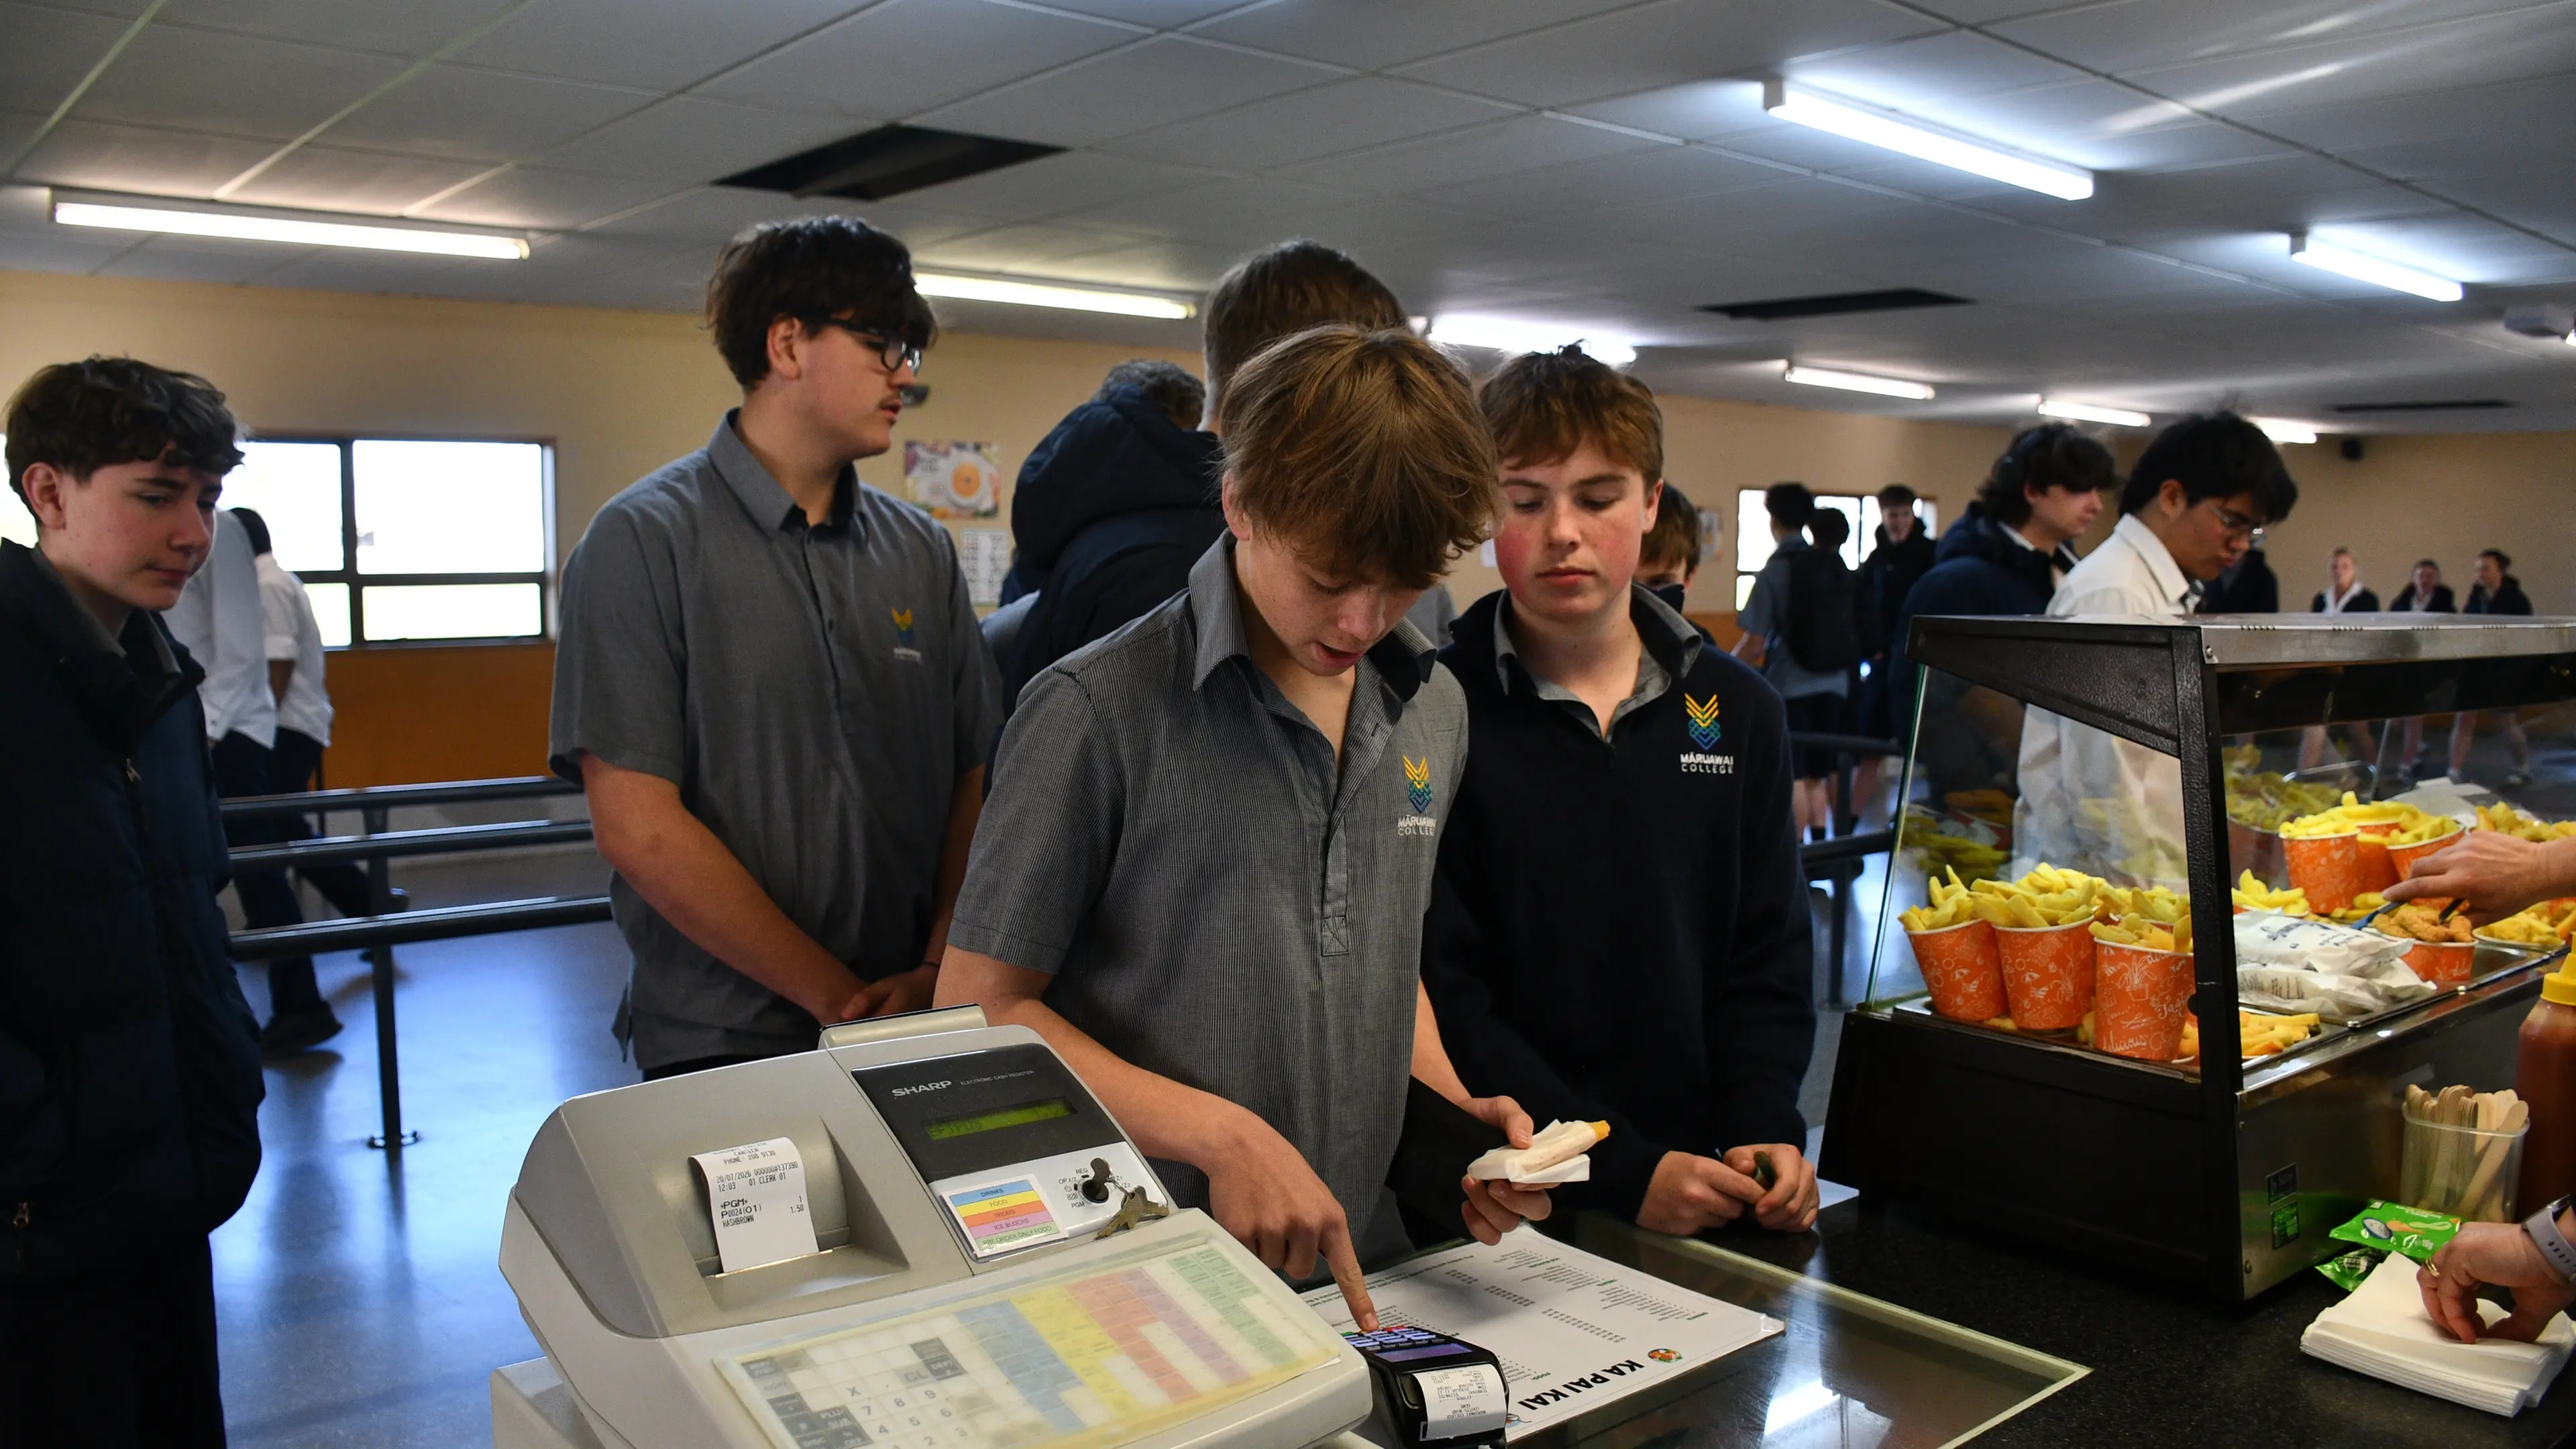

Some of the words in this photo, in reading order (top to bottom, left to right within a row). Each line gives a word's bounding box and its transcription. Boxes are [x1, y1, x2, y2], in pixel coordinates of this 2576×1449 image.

[1680, 752, 1733, 765] MĀRUAWAI
[1681, 763, 1733, 774] COLLEGE
[892, 1080, 952, 1096] SHARP
[960, 1076, 993, 1085] ELECTRONIC
[1008, 1070, 1034, 1078] REGISTER
[718, 1182, 736, 1192] 12:03
[749, 1178, 756, 1186] 01
[759, 1174, 777, 1185] CLERK
[779, 1172, 786, 1181] 01
[981, 1188, 1004, 1197] DRINKS
[790, 1203, 804, 1214] 1.50
[989, 1199, 1008, 1208] FOOD
[994, 1209, 1016, 1218] TREATS
[722, 1214, 755, 1228] HASHBROWN
[1006, 1218, 1029, 1228] BLOCKS
[983, 1237, 994, 1245] PRE
[995, 1232, 1018, 1243] ORDER
[1018, 1230, 1034, 1240] ONLY
[1034, 1226, 1052, 1234] FOOD
[1601, 1359, 1645, 1377] KA
[904, 1371, 928, 1382] CL
[1562, 1373, 1611, 1393] PAI
[846, 1387, 861, 1397] X
[861, 1405, 871, 1415] 7
[894, 1397, 906, 1407] 8
[924, 1389, 936, 1399] 9
[1517, 1388, 1570, 1411] KAI
[879, 1425, 890, 1434] 4
[908, 1416, 920, 1426] 5
[940, 1407, 952, 1417] 6
[924, 1436, 936, 1446] 2
[955, 1427, 968, 1437] 3
